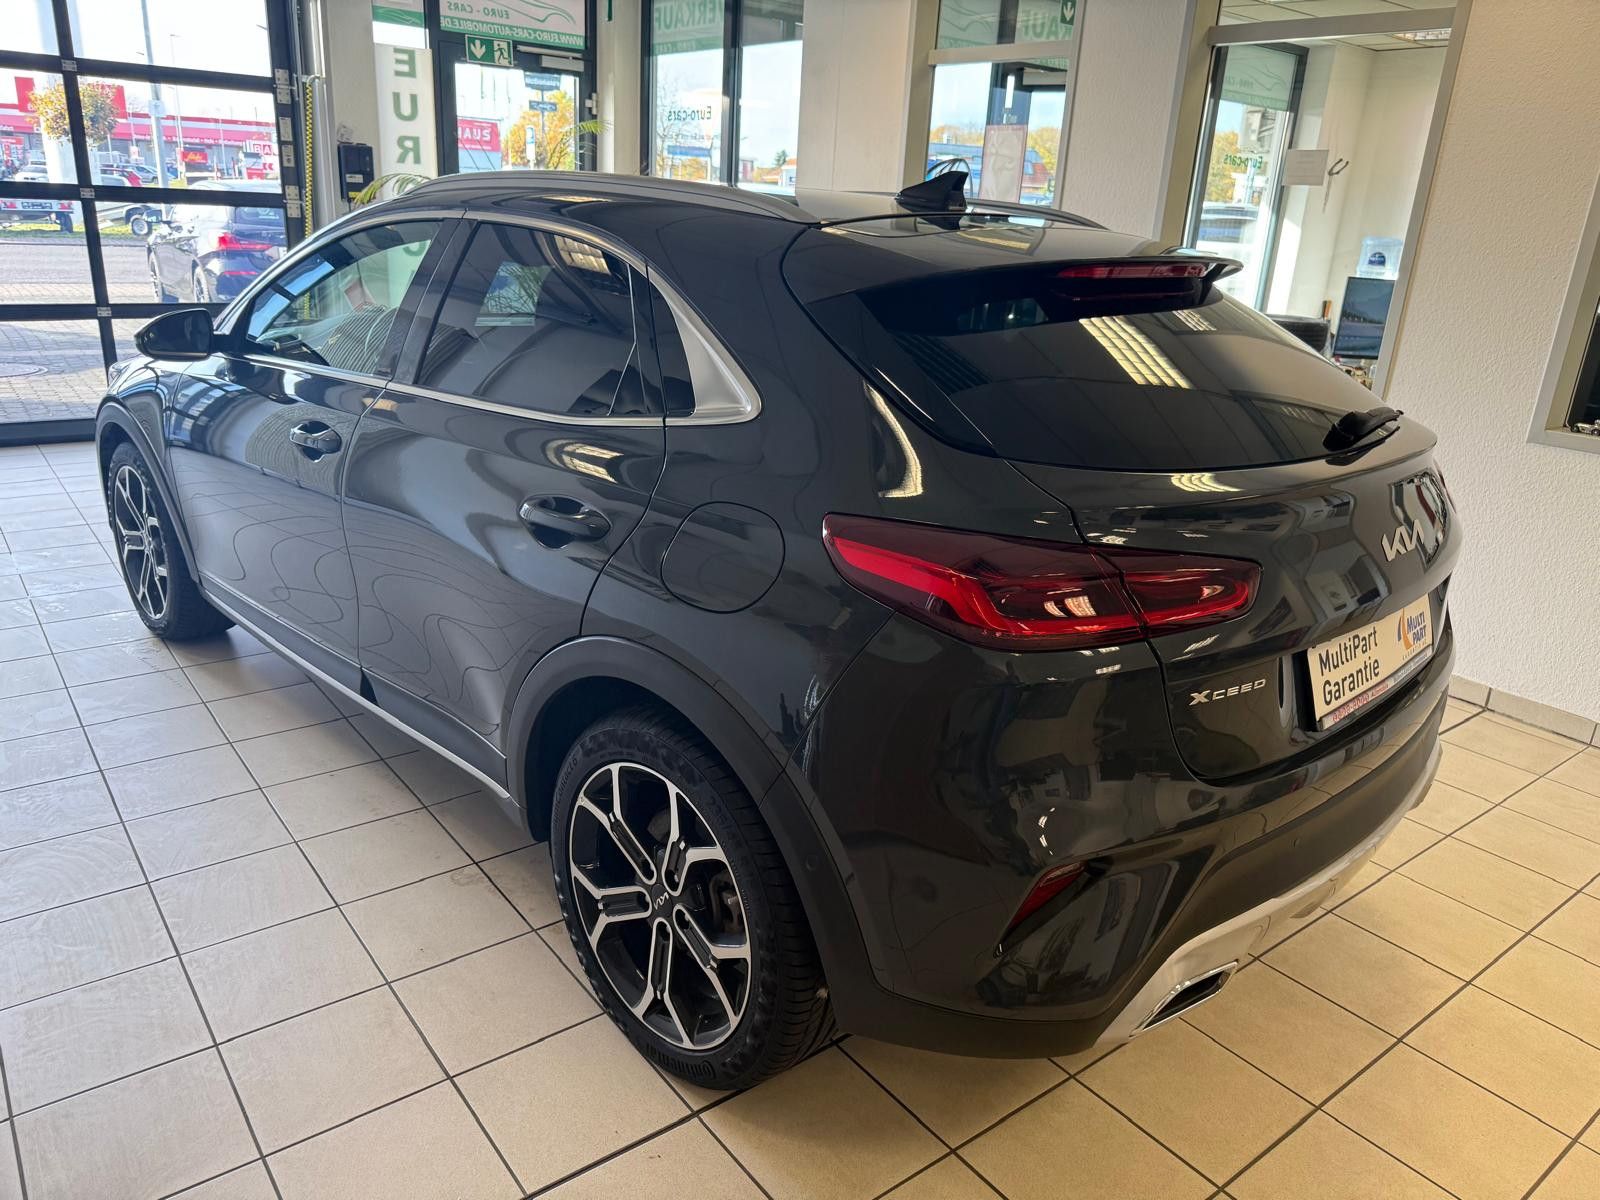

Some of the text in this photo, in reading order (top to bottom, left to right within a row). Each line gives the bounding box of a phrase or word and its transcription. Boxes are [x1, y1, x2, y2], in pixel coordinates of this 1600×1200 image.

[1381, 519, 1424, 562] KIA
[1318, 626, 1378, 677] MultiPart
[1412, 625, 1427, 645] PART
[1323, 656, 1380, 706] Garantie
